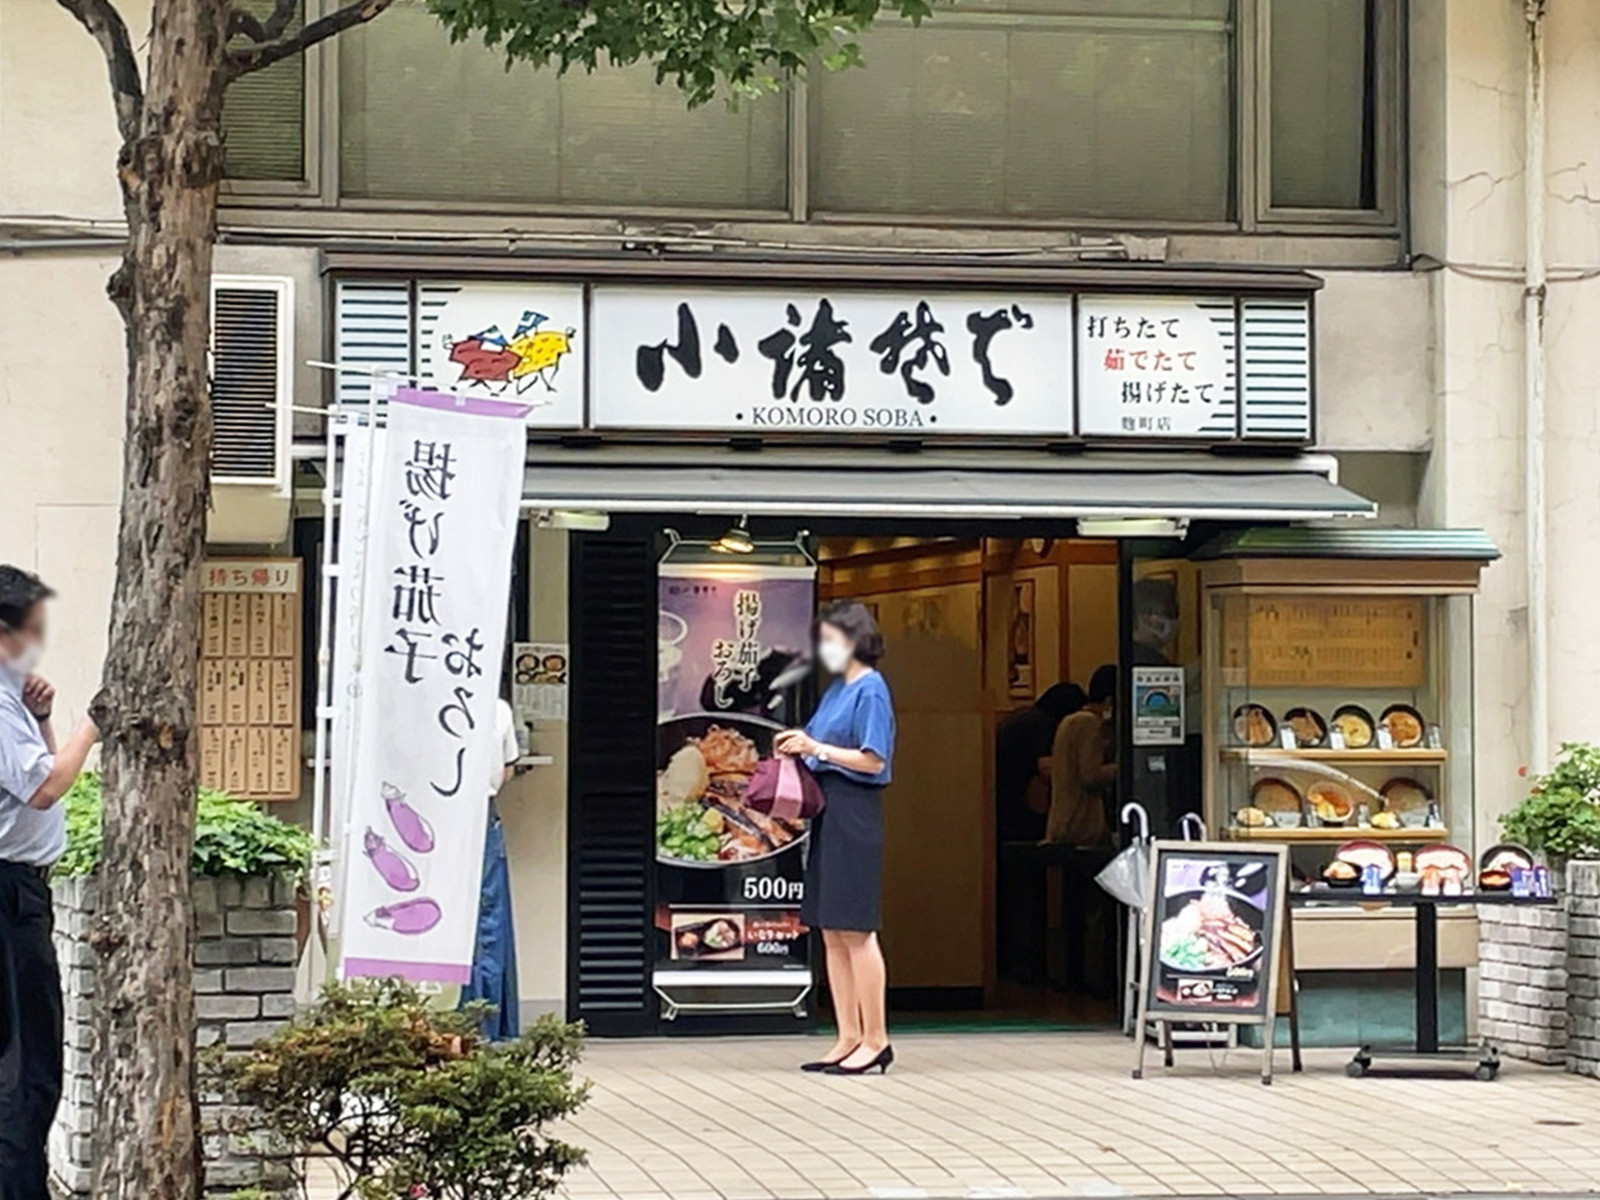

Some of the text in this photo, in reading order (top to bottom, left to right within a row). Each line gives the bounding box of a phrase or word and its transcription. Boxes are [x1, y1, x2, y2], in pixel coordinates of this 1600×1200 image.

[1087, 315, 1180, 338] 打ちたて
[1104, 348, 1197, 371] 茹でたて
[1121, 381, 1214, 404] 揚げたて
[752, 407, 924, 428] KOMORO SOBA
[209, 567, 289, 587] 持ち帰り
[743, 876, 804, 900] 500円
